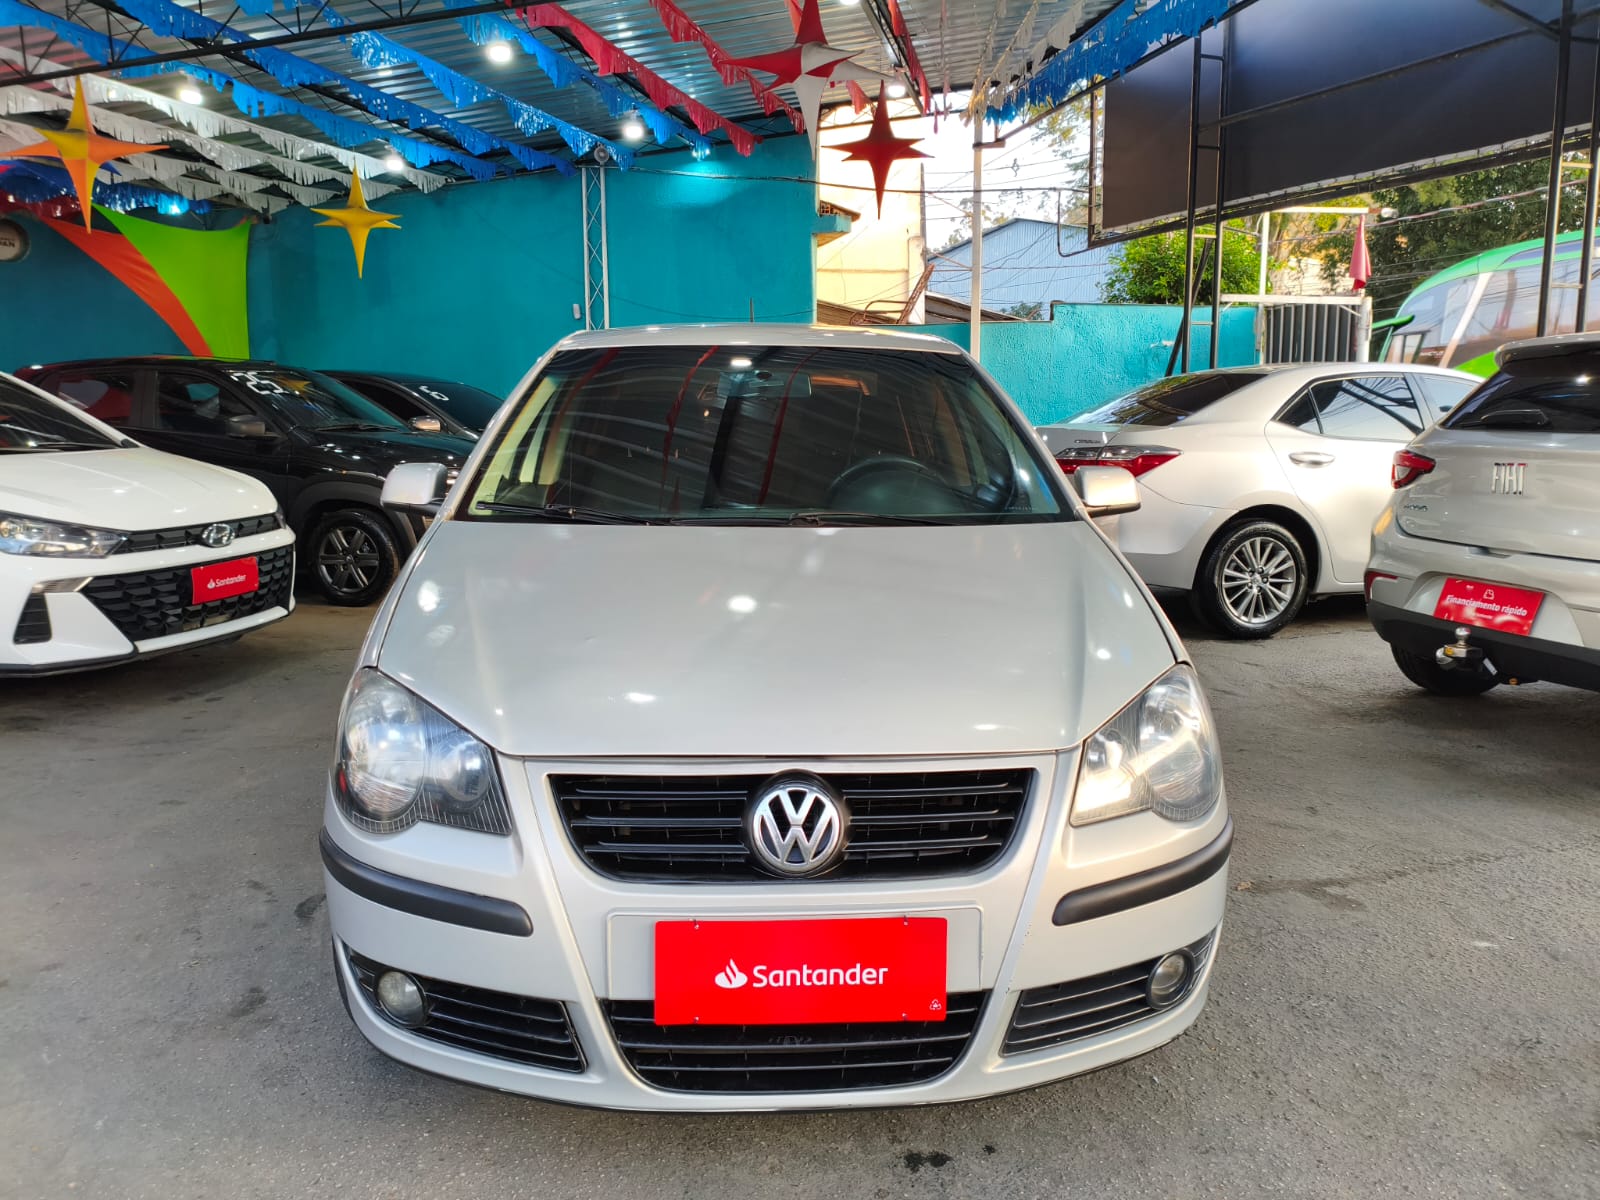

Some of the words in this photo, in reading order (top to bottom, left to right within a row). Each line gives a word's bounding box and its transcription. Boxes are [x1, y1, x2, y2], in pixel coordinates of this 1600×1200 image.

[1491, 462, 1527, 495] FIAT
[215, 574, 247, 588] Santander
[1446, 594, 1501, 612] Financiamento
[1501, 605, 1528, 617] rápido
[752, 963, 889, 988] Santander
